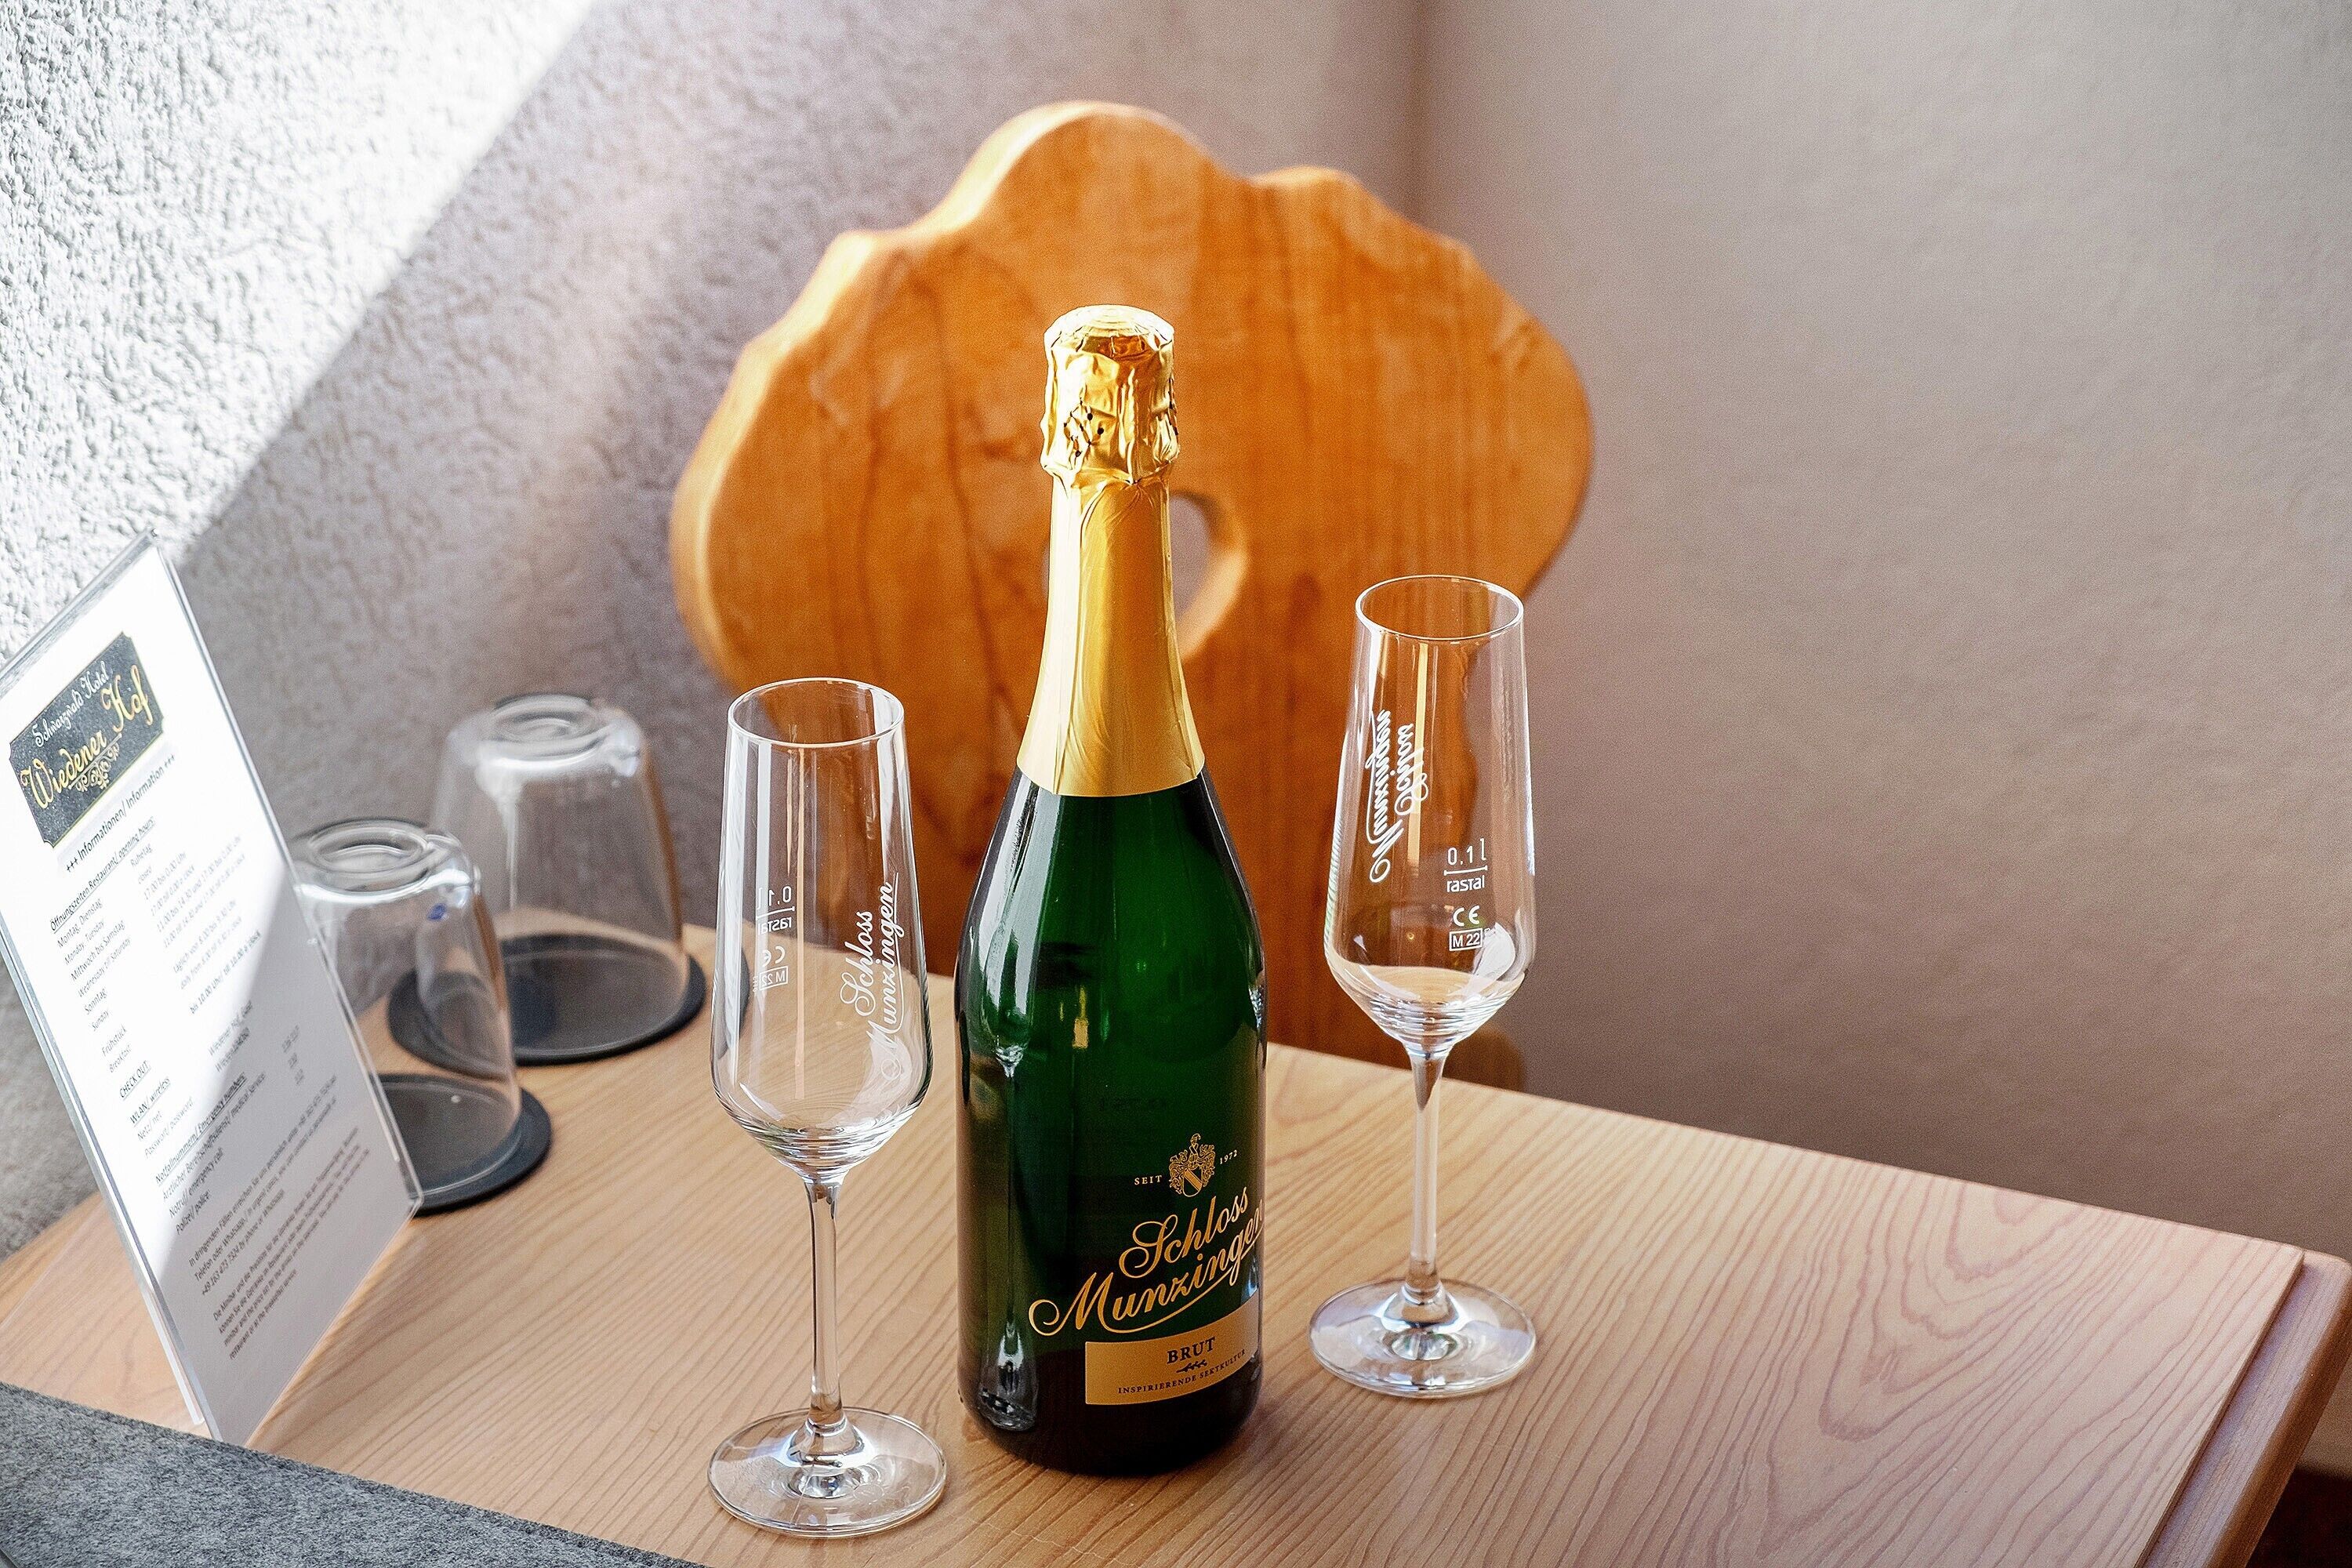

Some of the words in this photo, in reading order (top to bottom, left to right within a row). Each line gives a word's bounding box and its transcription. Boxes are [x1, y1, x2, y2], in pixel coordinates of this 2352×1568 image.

[32, 688, 84, 747] Schwarzwald
[82, 660, 110, 699] Hotel
[20, 730, 107, 809] Wiedener
[100, 665, 153, 732] Hof
[78, 803, 125, 860] Informationen/
[125, 767, 164, 808] Information
[1446, 874, 1485, 893] rastal
[1452, 935, 1464, 948] M
[1465, 932, 1480, 946] 22
[1453, 905, 1480, 927] CE
[71, 952, 96, 981] Mittwoch
[103, 920, 125, 946] Samstag
[840, 911, 876, 1017] Schloss
[866, 873, 906, 1080] Munzingen
[119, 1076, 137, 1098] CHECK
[1134, 1174, 1163, 1186] SEIT
[1219, 1149, 1239, 1166] 1972
[1118, 1185, 1248, 1279] Schloss
[1028, 1198, 1264, 1337] Munzingen
[1118, 1374, 1197, 1395] INSPIRIERENDE
[1199, 1348, 1247, 1379] SEKTKULTUR
[1166, 1336, 1216, 1365] BRUT
